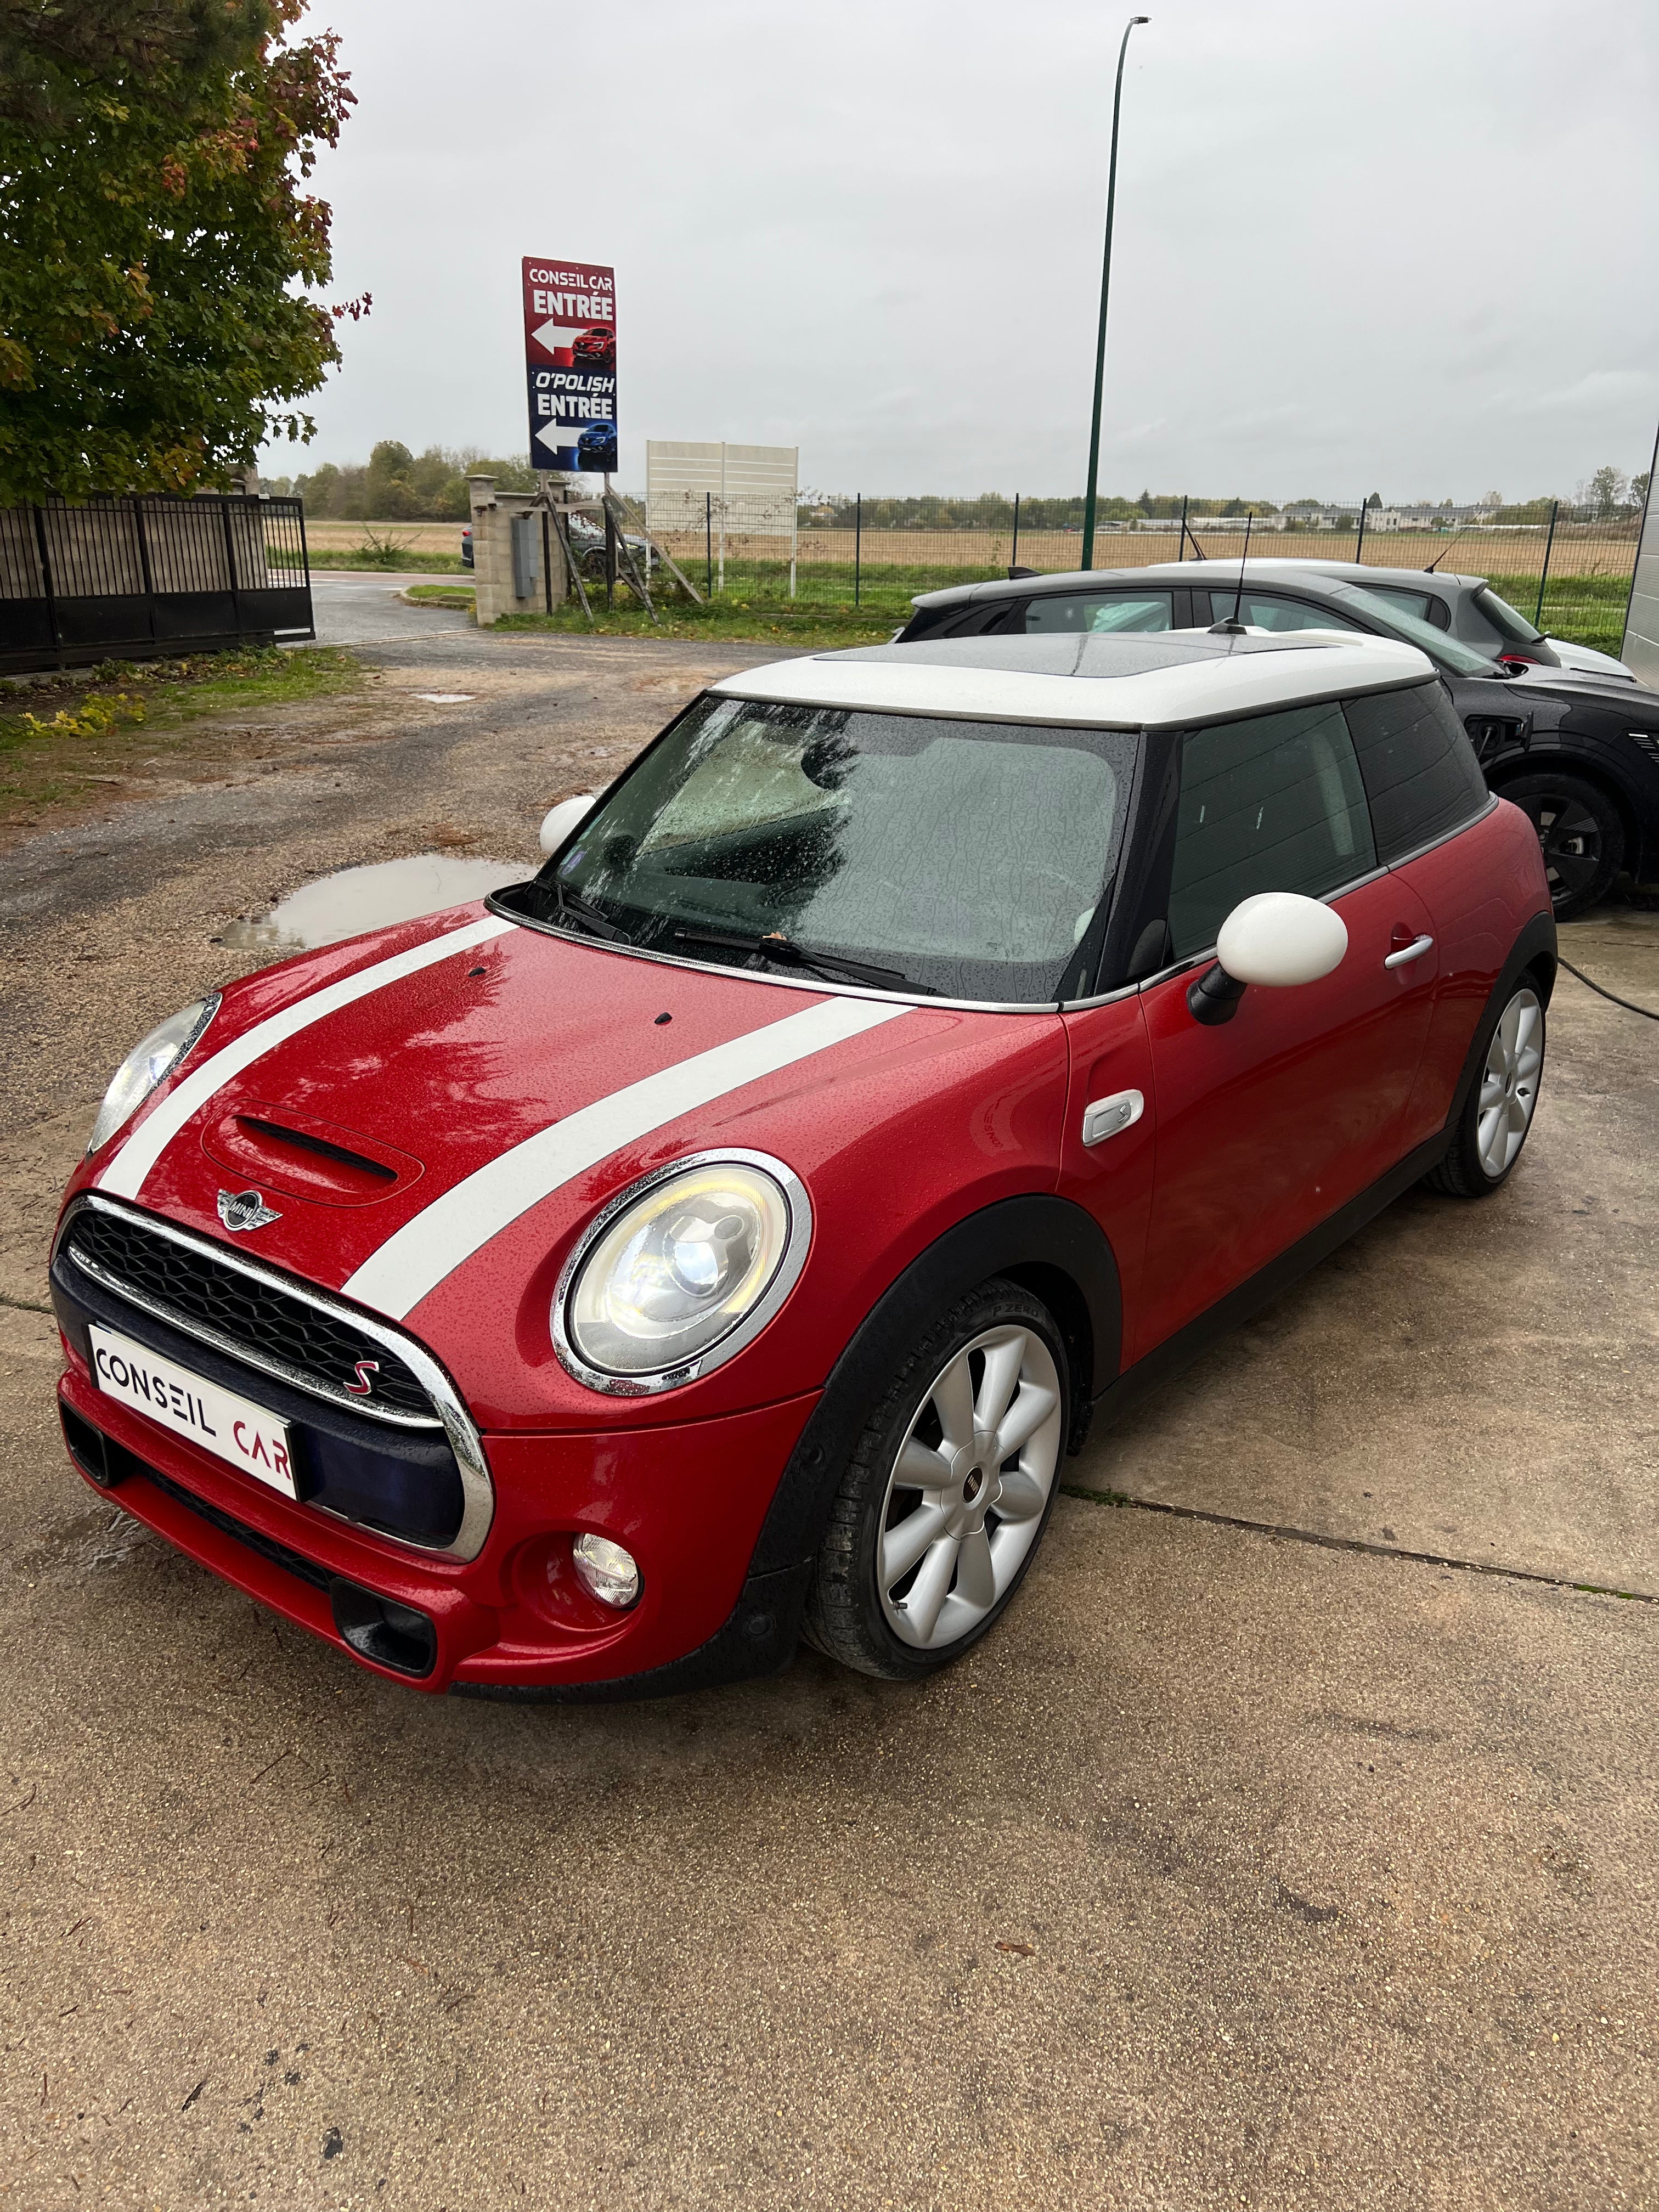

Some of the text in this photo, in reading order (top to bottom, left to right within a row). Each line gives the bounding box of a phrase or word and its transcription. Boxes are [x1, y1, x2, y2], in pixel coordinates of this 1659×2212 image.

[529, 268, 613, 291] CONSEIL CAR
[533, 289, 613, 321] ENTRÉE
[535, 372, 615, 393] O'POLISH
[537, 393, 613, 420] ENTRÉE
[229, 1201, 253, 1218] MINI
[1005, 1304, 1039, 1318] ZERO
[343, 1361, 380, 1395] S
[96, 1348, 292, 1480] CONSEIL CAR
